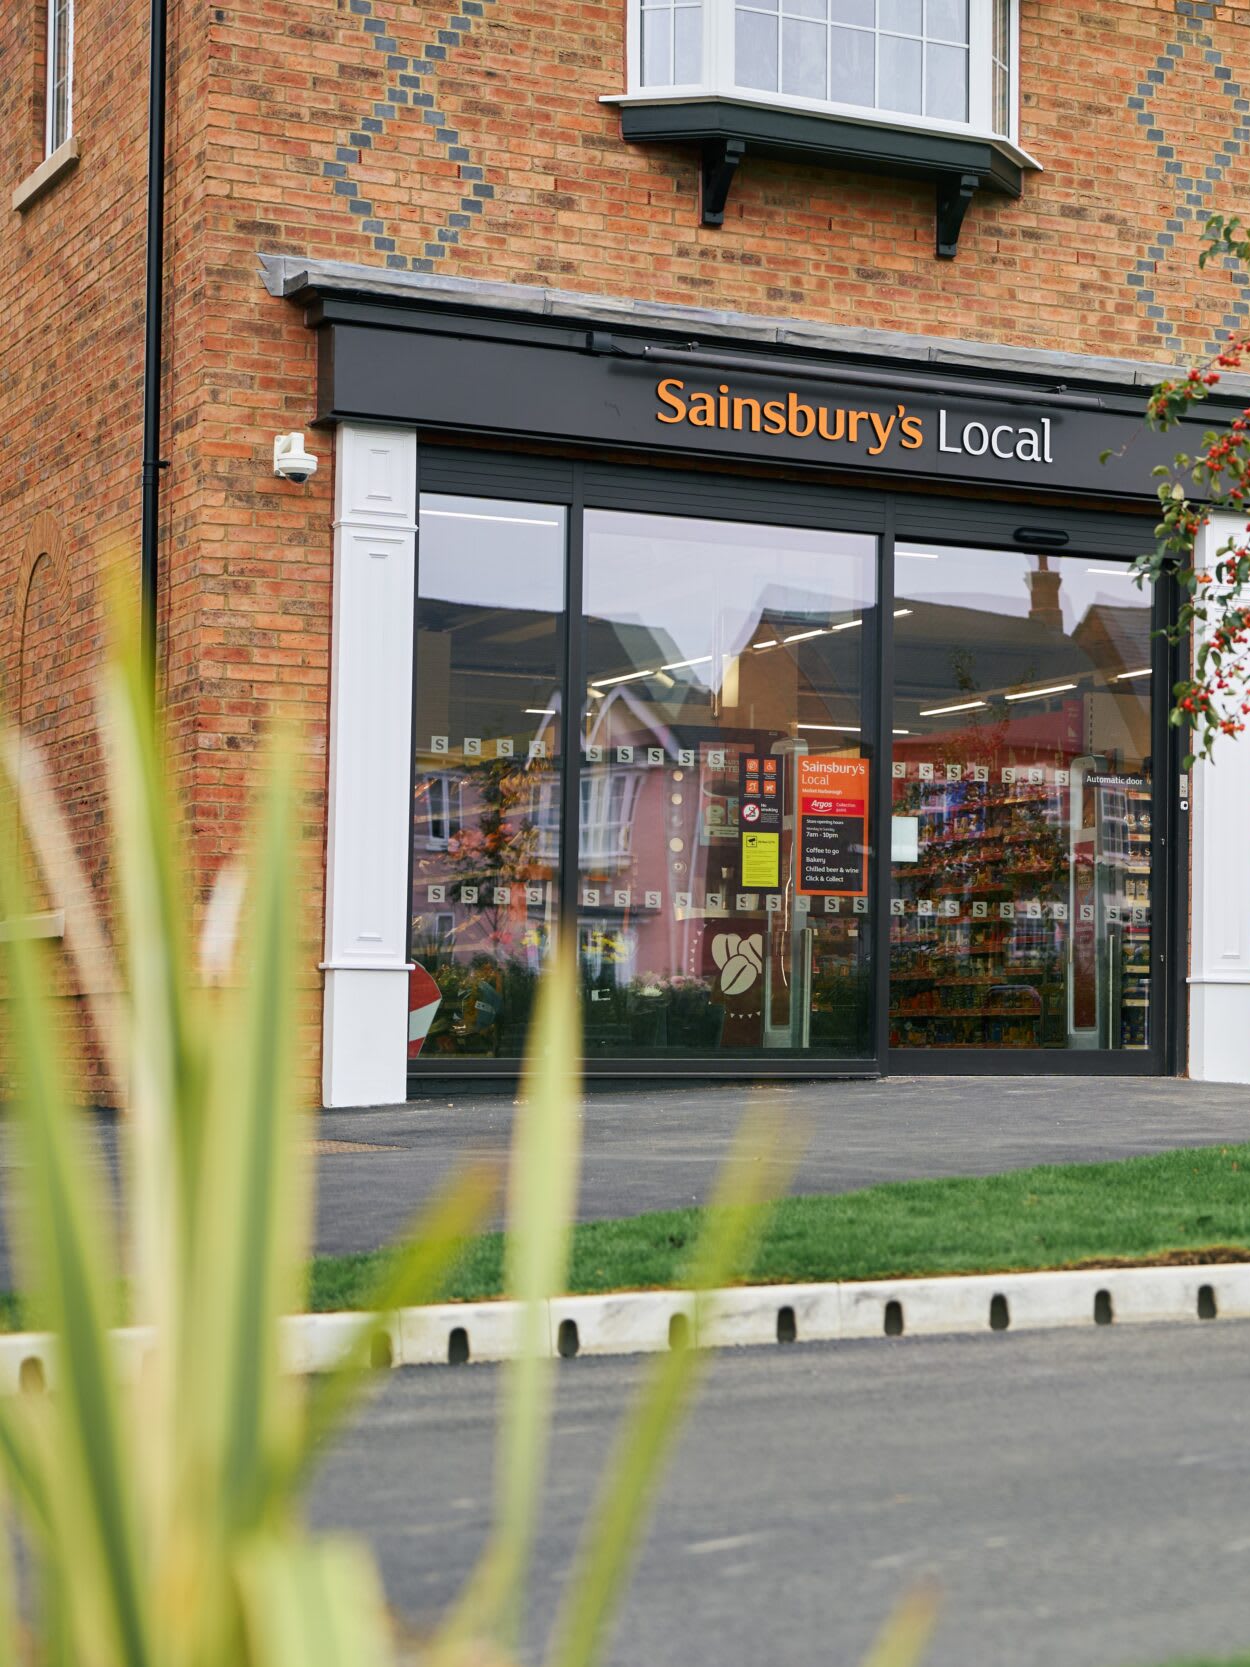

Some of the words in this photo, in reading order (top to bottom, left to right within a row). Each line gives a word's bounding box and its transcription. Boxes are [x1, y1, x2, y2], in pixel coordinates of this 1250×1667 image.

[655, 378, 924, 456] Sainsbury's
[938, 409, 1054, 464] Local
[802, 760, 865, 777] Sainsbury's
[802, 774, 829, 785] Local
[1086, 775, 1125, 785] Automatic
[1126, 776, 1143, 785] door
[811, 800, 833, 809] Argos
